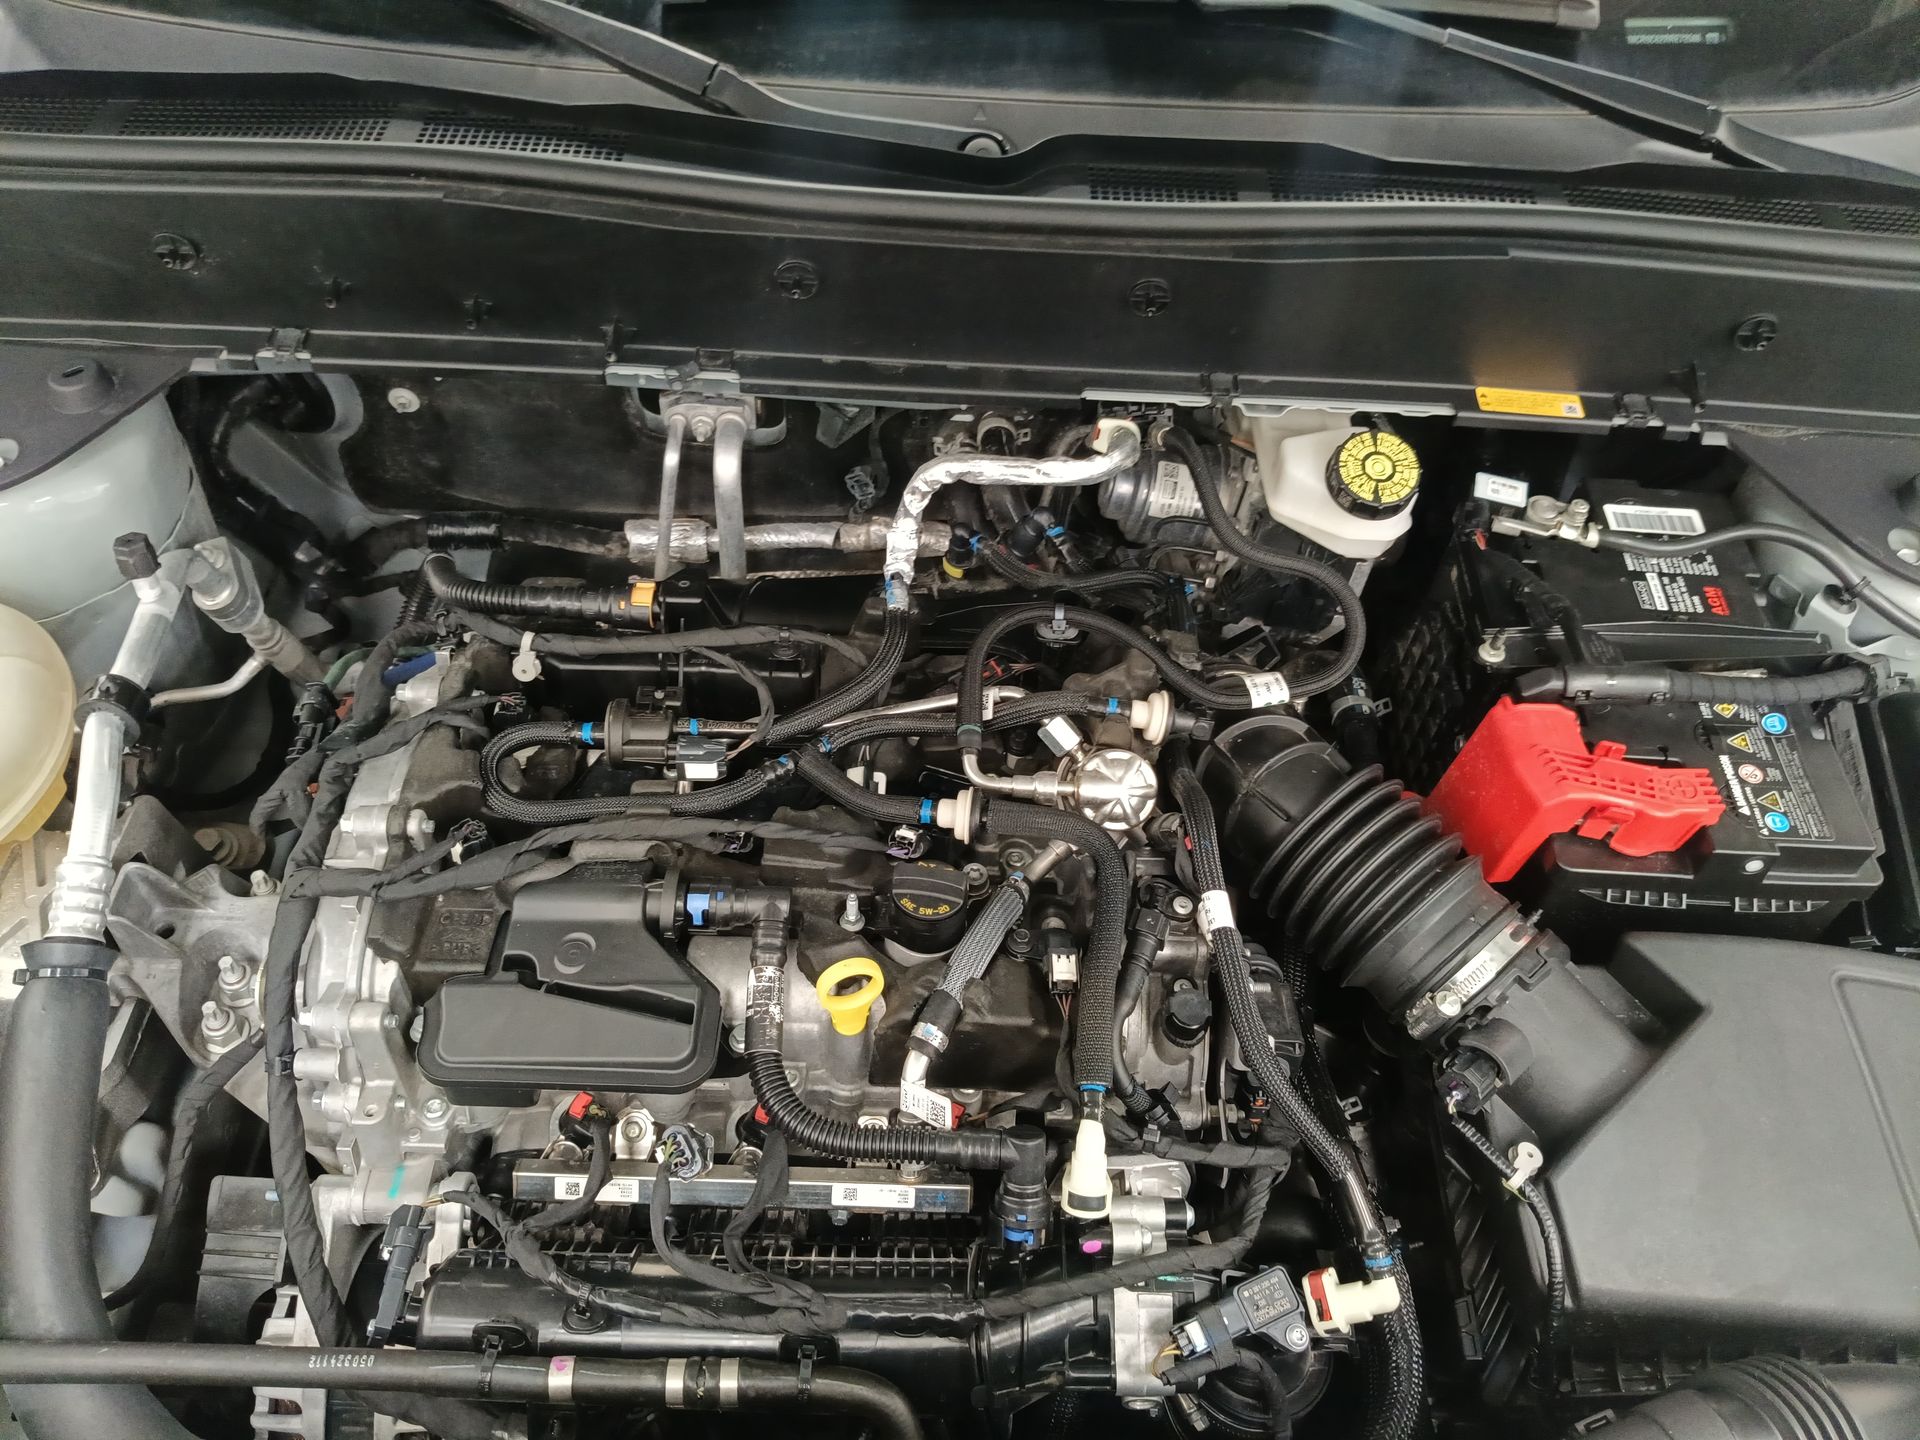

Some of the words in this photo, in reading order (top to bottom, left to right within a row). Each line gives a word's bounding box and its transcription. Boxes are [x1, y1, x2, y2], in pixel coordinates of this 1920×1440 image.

[1703, 586, 1724, 615] AGM
[900, 897, 917, 911] SAE
[918, 904, 950, 915] 5W-20
